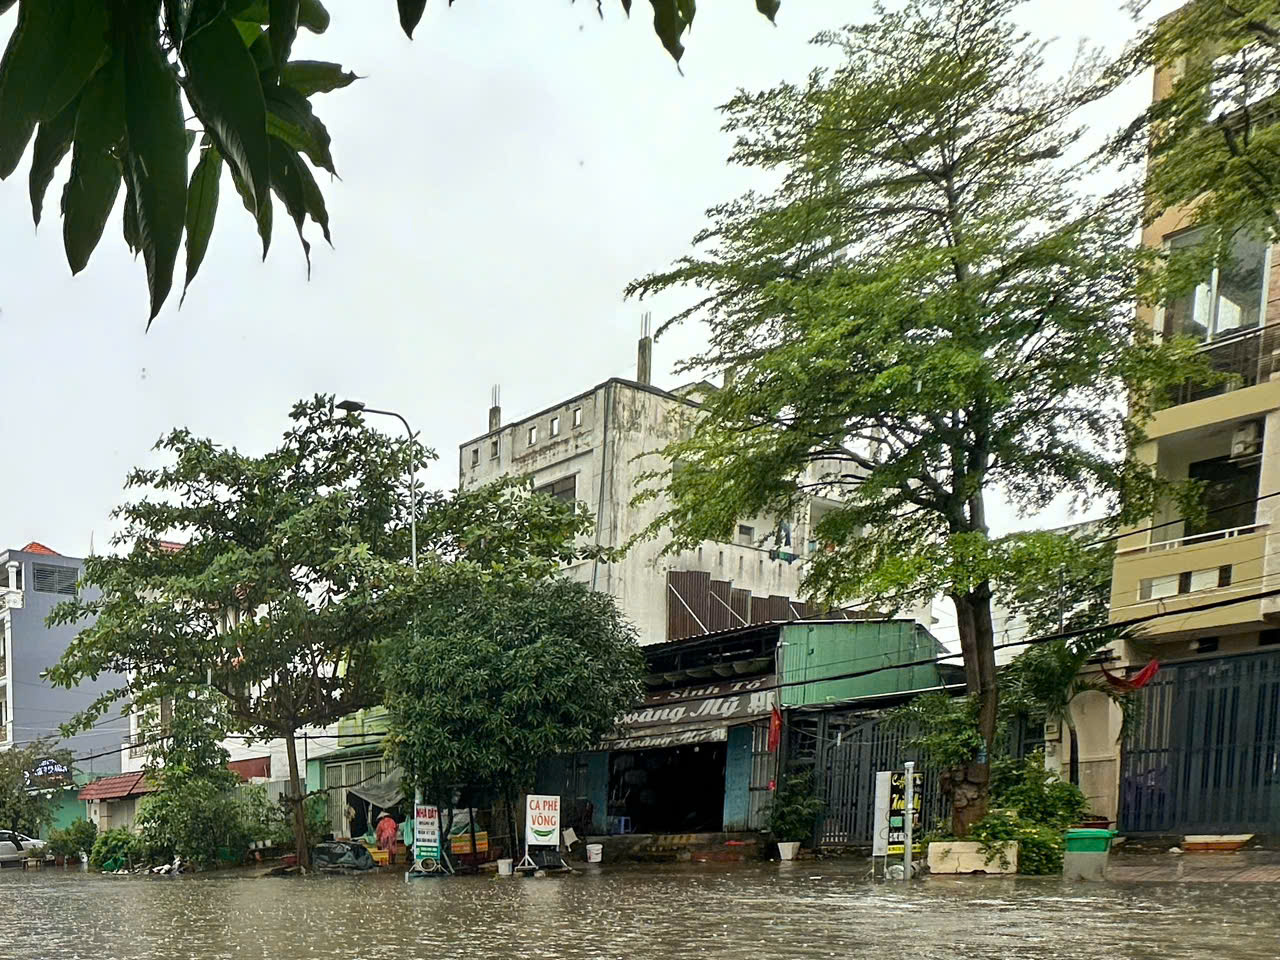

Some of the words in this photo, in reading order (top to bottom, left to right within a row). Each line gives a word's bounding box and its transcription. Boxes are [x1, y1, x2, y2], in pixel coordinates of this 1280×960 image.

[668, 686, 720, 700] Sinh
[730, 678, 767, 692] Tố
[690, 696, 740, 717] Mỹ
[543, 797, 559, 811] PHÊ
